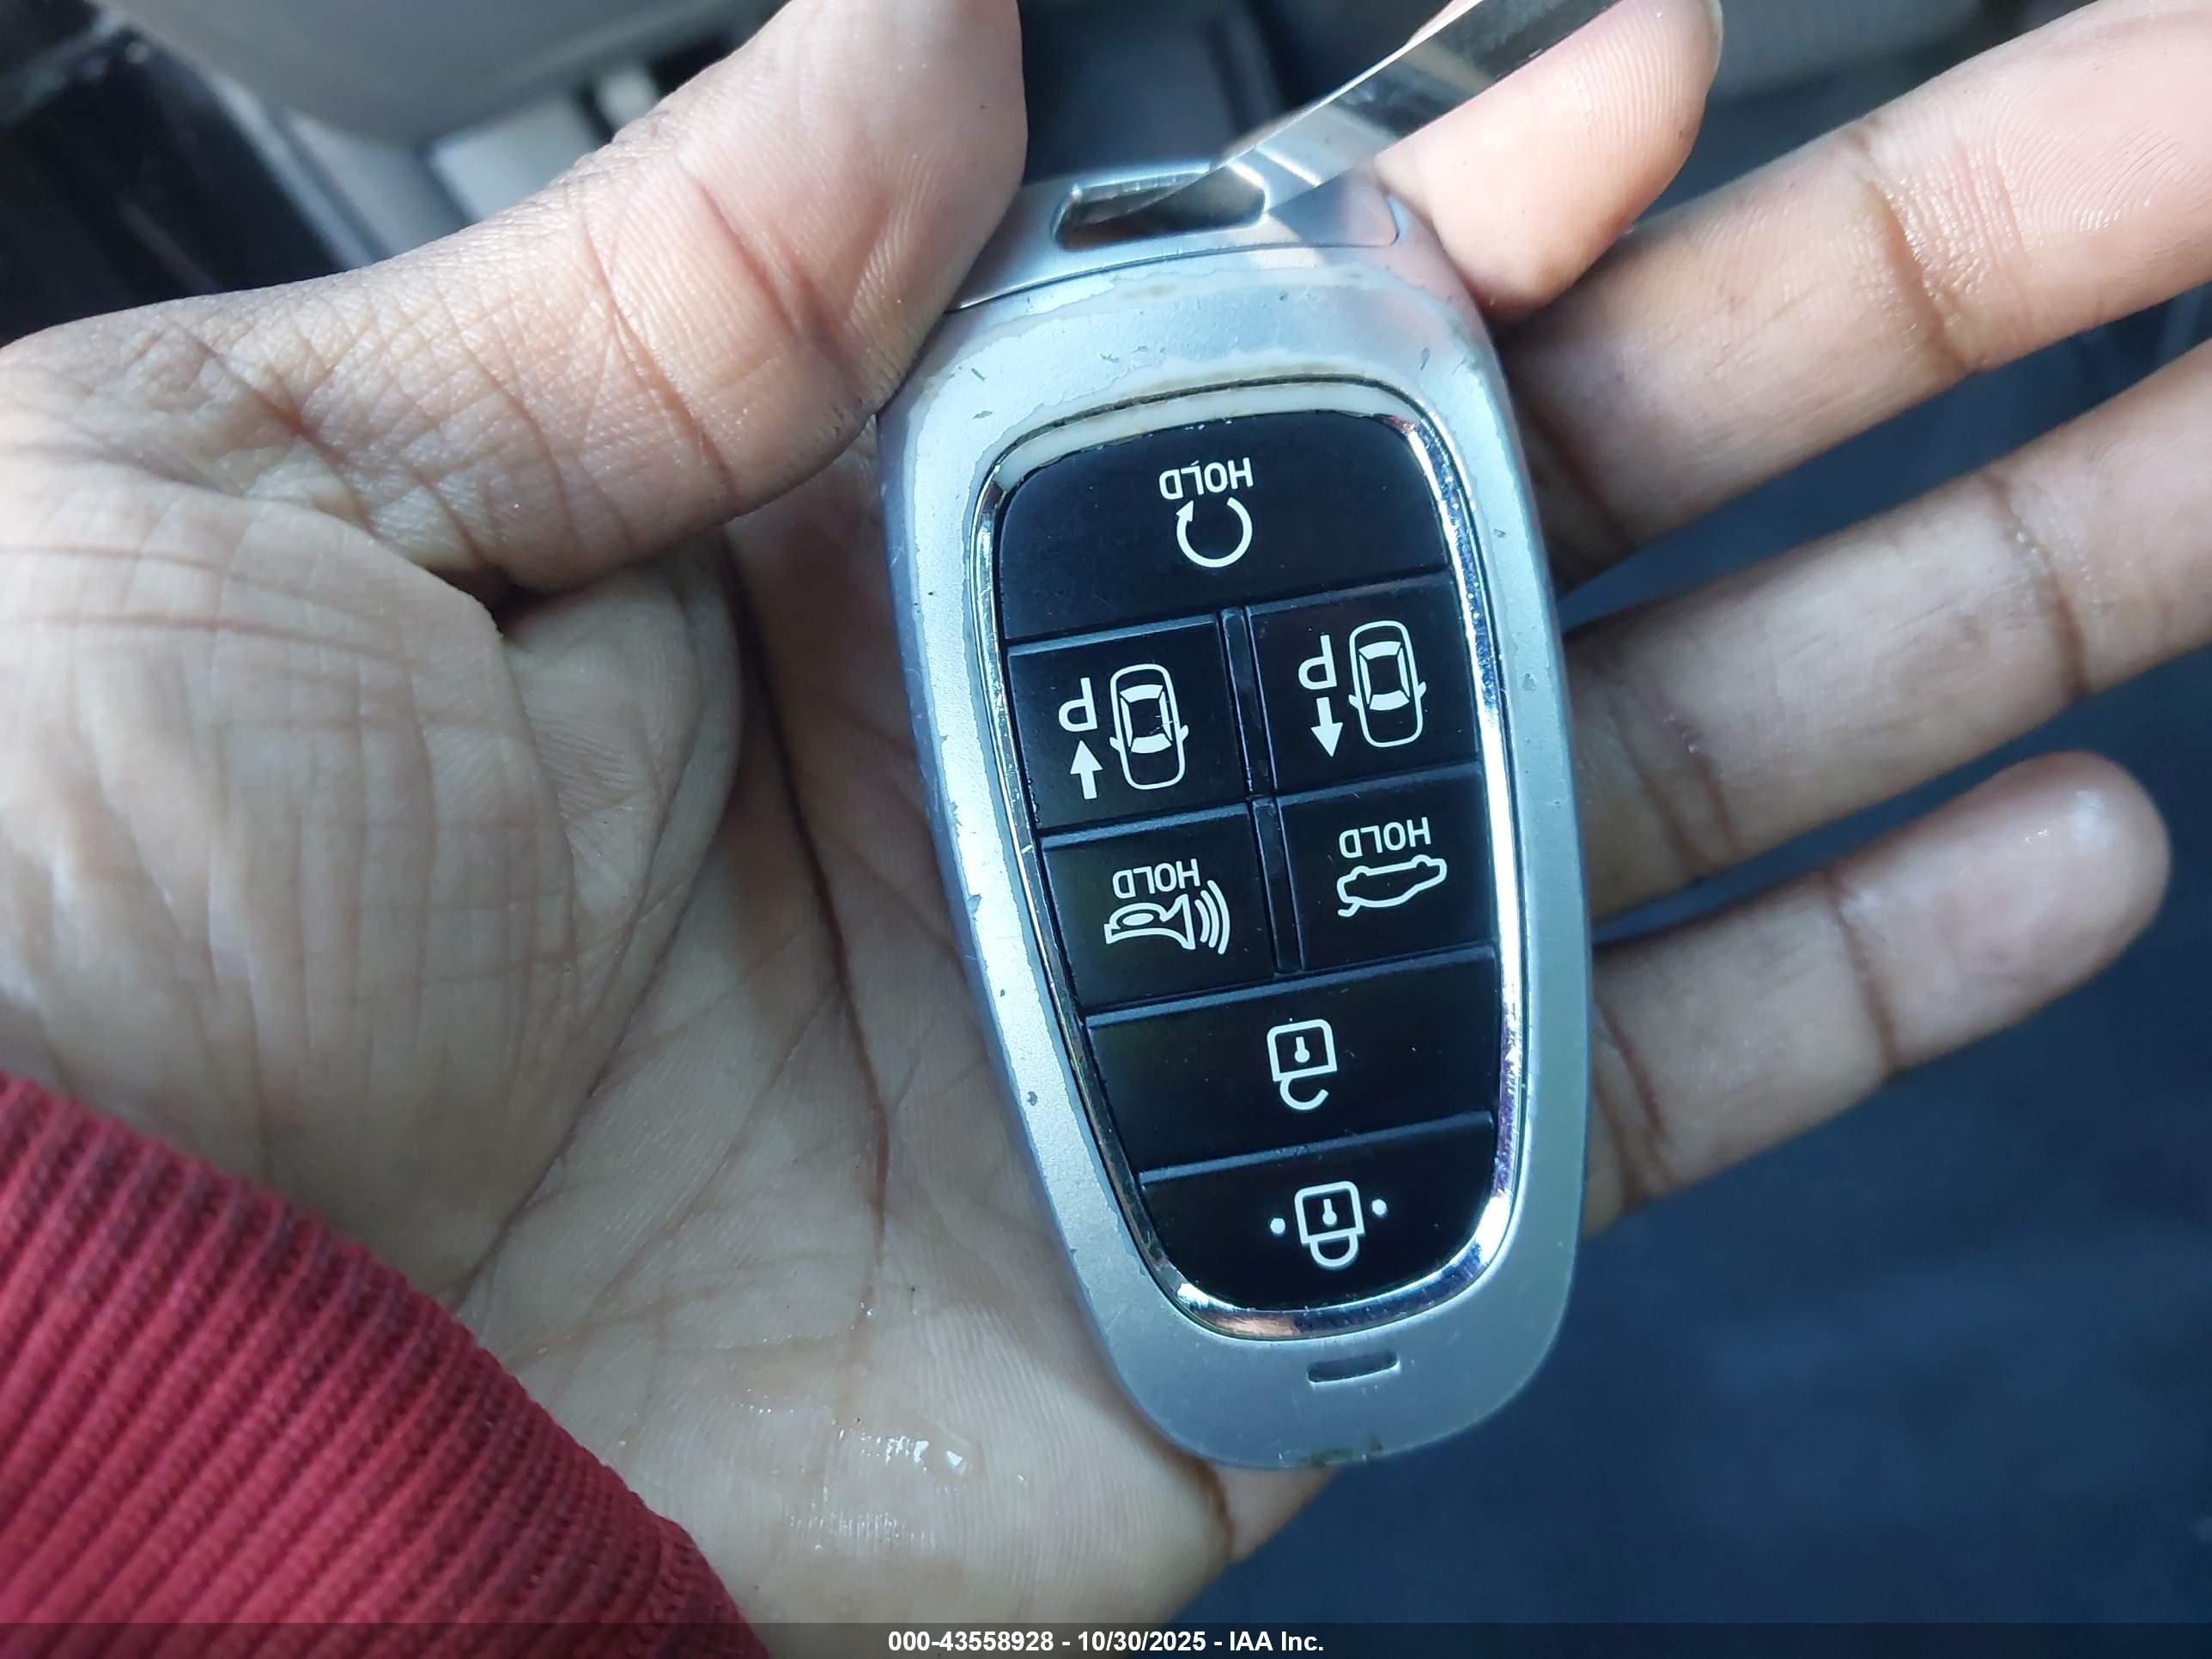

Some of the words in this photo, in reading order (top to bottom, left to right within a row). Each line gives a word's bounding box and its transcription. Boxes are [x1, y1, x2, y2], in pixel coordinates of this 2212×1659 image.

[1158, 457, 1255, 500] HOLD
[1297, 635, 1338, 690] P
[1058, 677, 1098, 732] P
[1339, 817, 1431, 859] HOLD
[1112, 858, 1201, 899] HOLD
